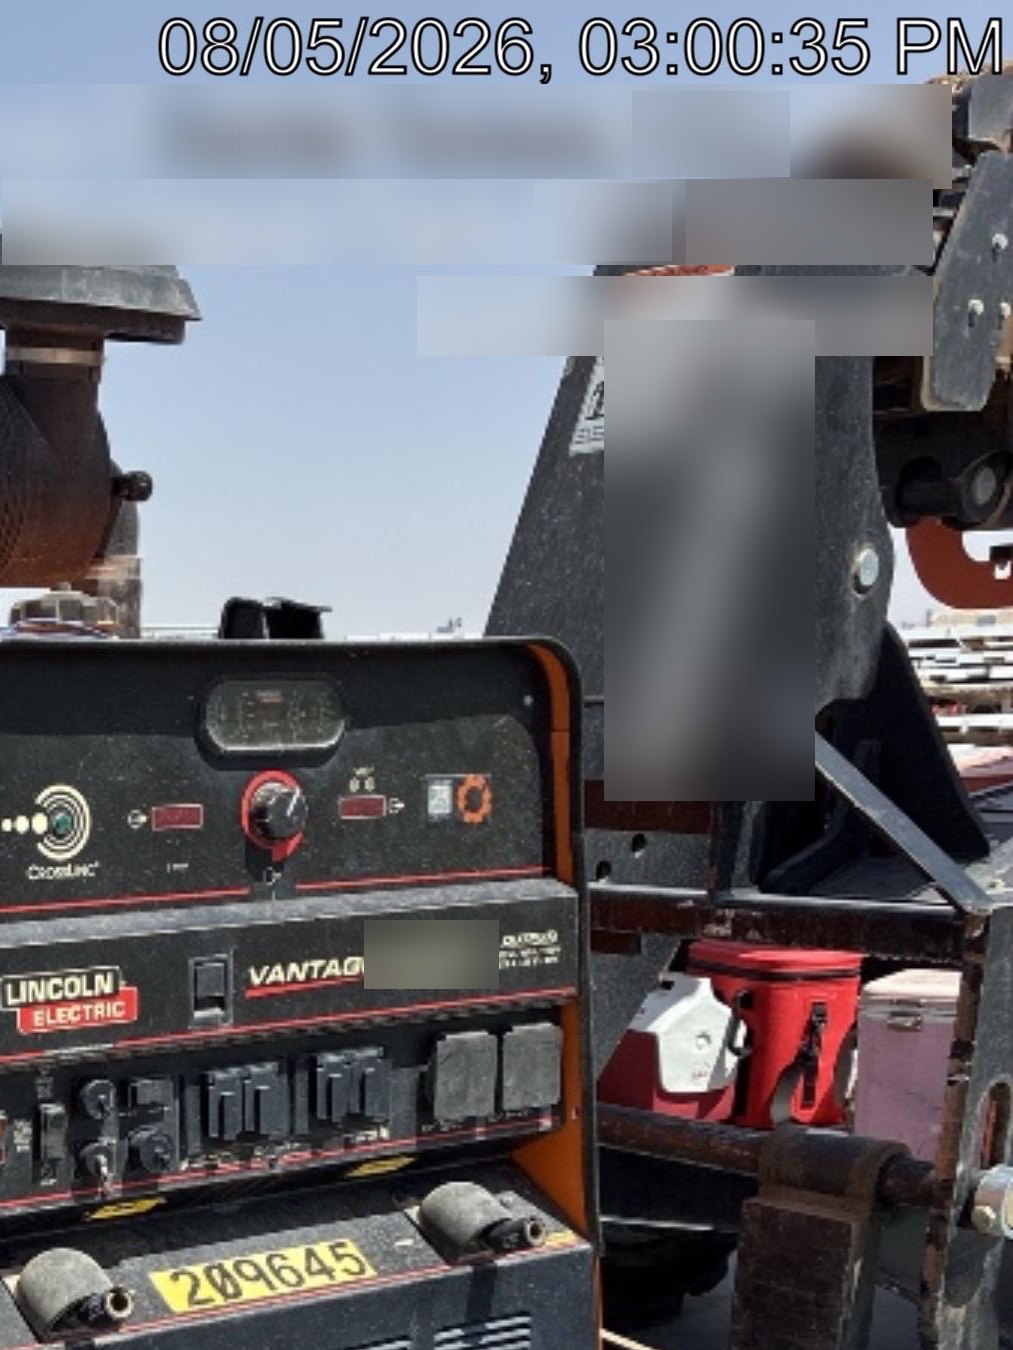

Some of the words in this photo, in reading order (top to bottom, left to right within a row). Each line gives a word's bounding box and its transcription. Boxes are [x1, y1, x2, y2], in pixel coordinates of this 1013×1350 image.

[249, 956, 365, 986] VANTAG
[6, 972, 114, 1006] LINCOLN
[33, 1001, 126, 1027] ELECTRIC
[169, 1242, 366, 1308] 209645
